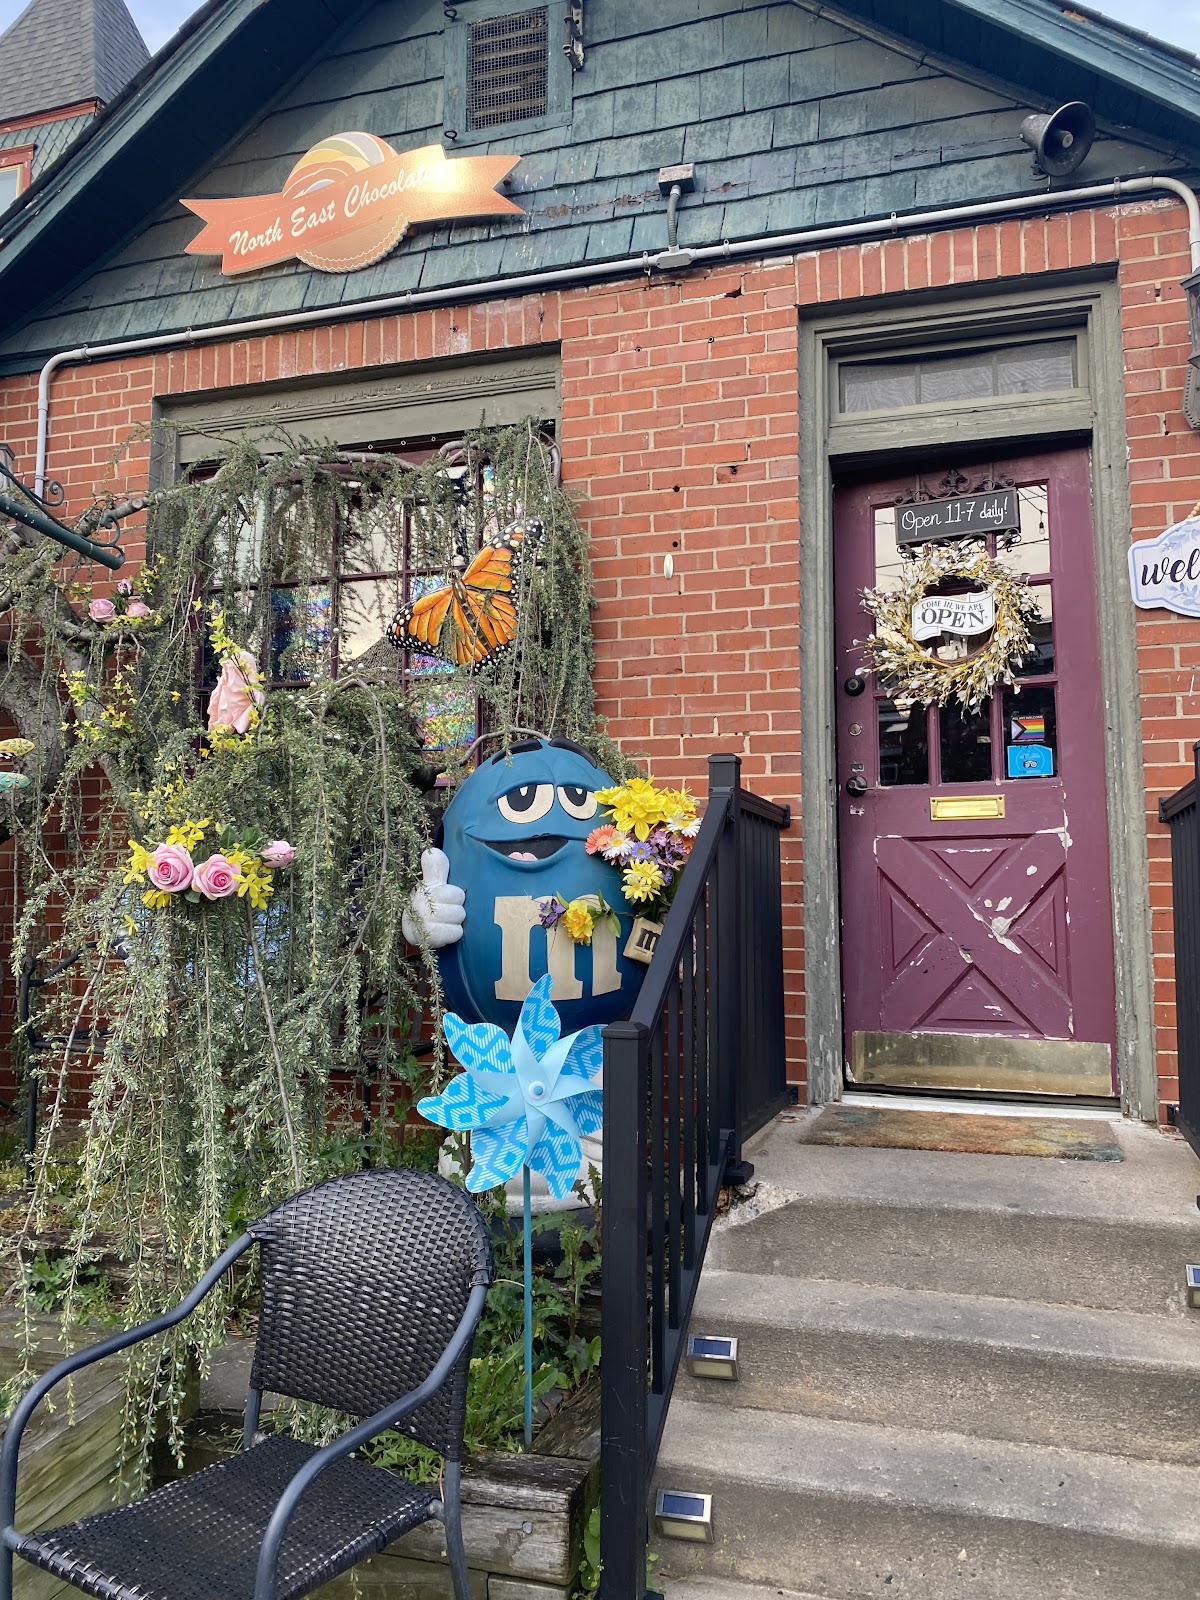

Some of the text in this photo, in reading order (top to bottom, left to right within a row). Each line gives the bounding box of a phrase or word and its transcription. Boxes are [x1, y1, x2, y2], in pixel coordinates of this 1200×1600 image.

[229, 217, 283, 256] North
[290, 196, 336, 237] East
[901, 496, 1009, 536] Open 11-7 daily!
[921, 601, 941, 609] COME
[955, 603, 965, 611] WE
[968, 603, 983, 611] ARE
[921, 608, 985, 628] OPEN
